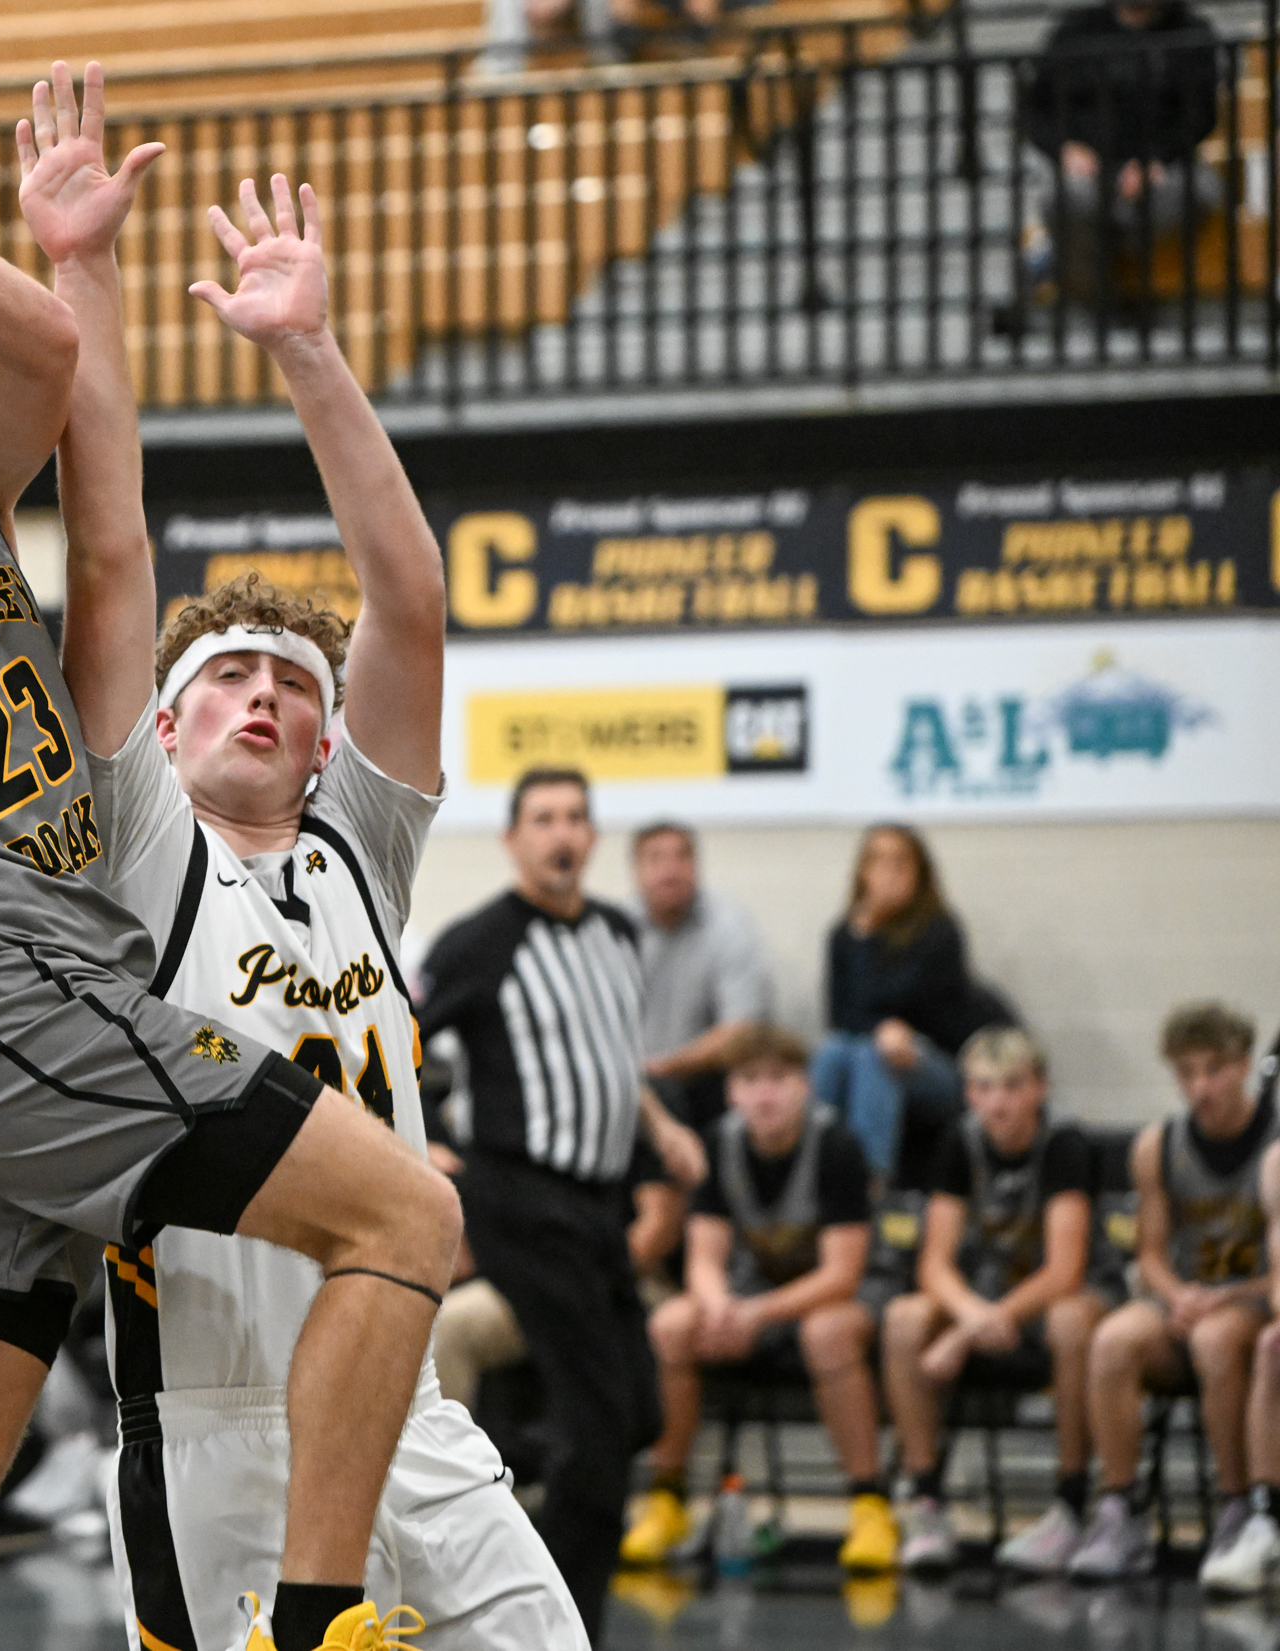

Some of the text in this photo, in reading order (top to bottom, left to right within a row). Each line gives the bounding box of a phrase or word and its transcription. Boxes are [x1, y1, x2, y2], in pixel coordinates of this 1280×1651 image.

[447, 510, 538, 628] C
[848, 496, 942, 614] C
[3, 792, 102, 878] DOAK
